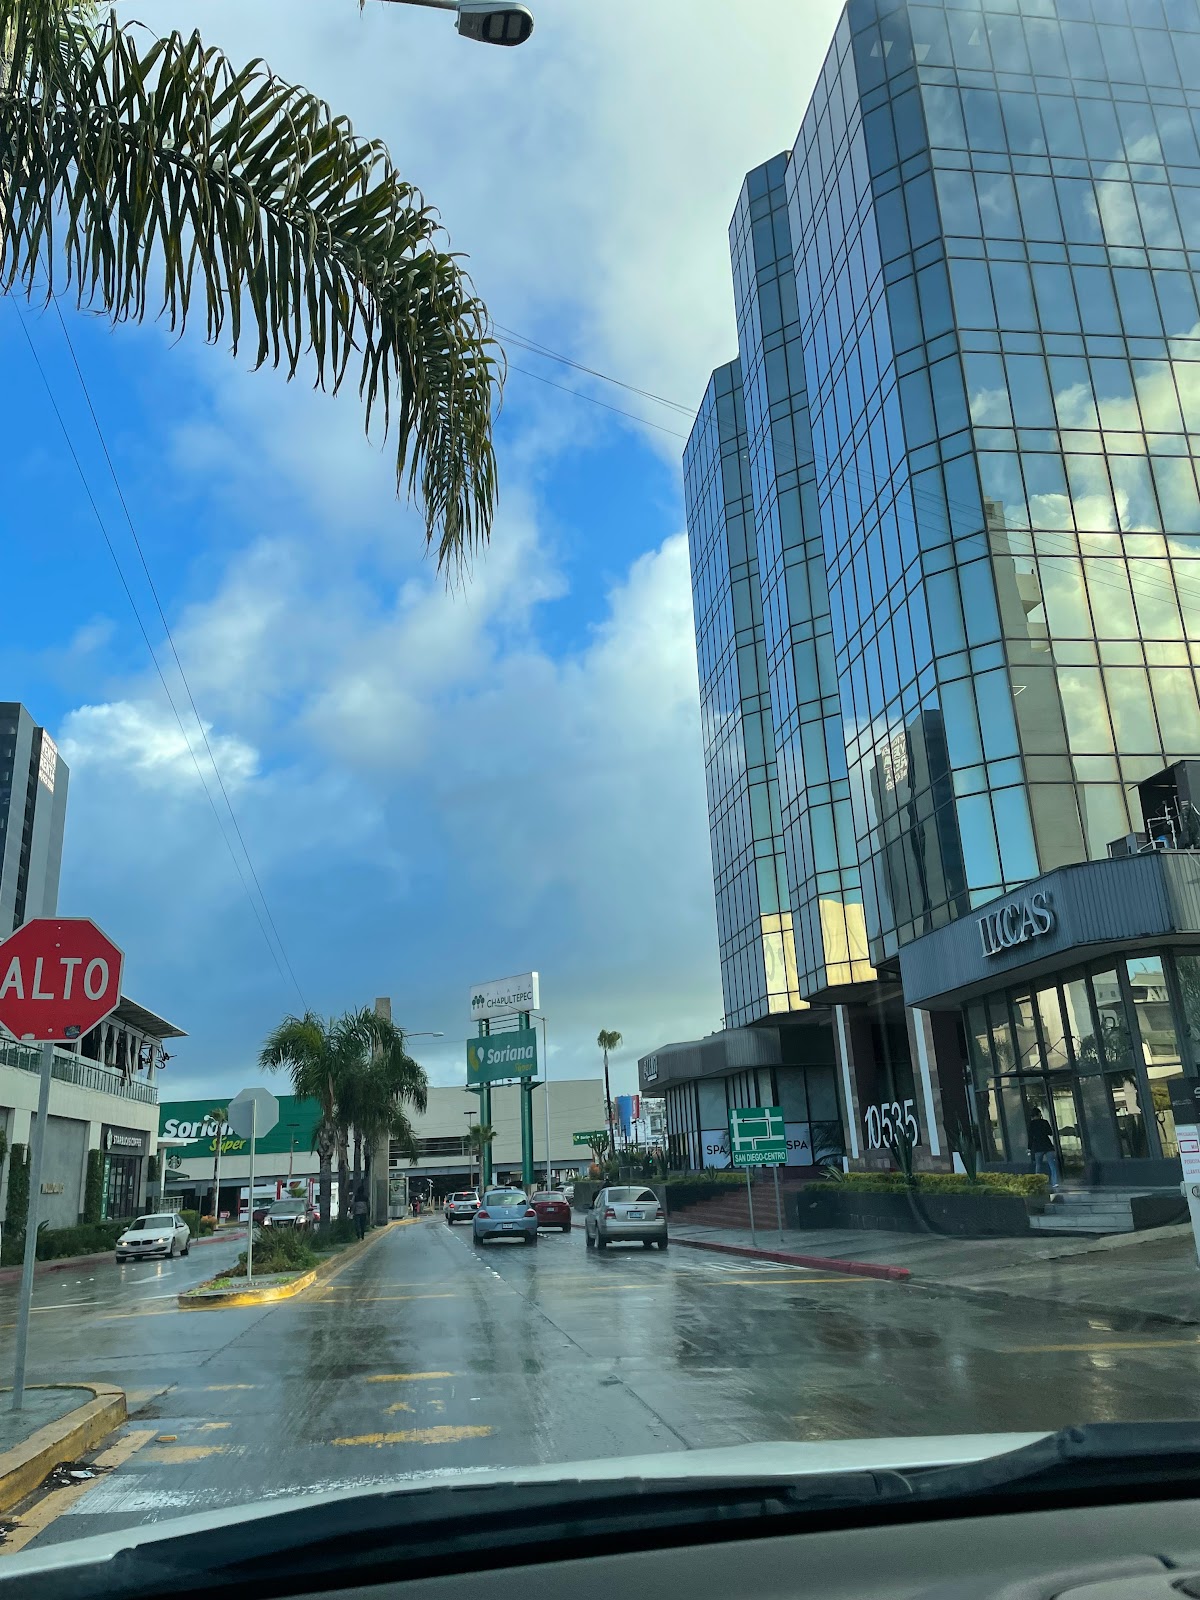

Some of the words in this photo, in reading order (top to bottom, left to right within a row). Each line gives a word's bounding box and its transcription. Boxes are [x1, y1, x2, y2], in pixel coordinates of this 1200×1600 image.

[0, 956, 109, 1000] ALTO
[486, 991, 533, 1008] CHAPULTEPEC
[486, 1045, 534, 1065] Soriana
[162, 1118, 234, 1138] Sorian
[864, 1098, 918, 1149] 10535
[706, 1144, 727, 1155] SPA
[786, 1140, 809, 1150] SPA
[734, 1154, 746, 1163] SAN
[746, 1151, 786, 1162] DIEGO-CENTRO
